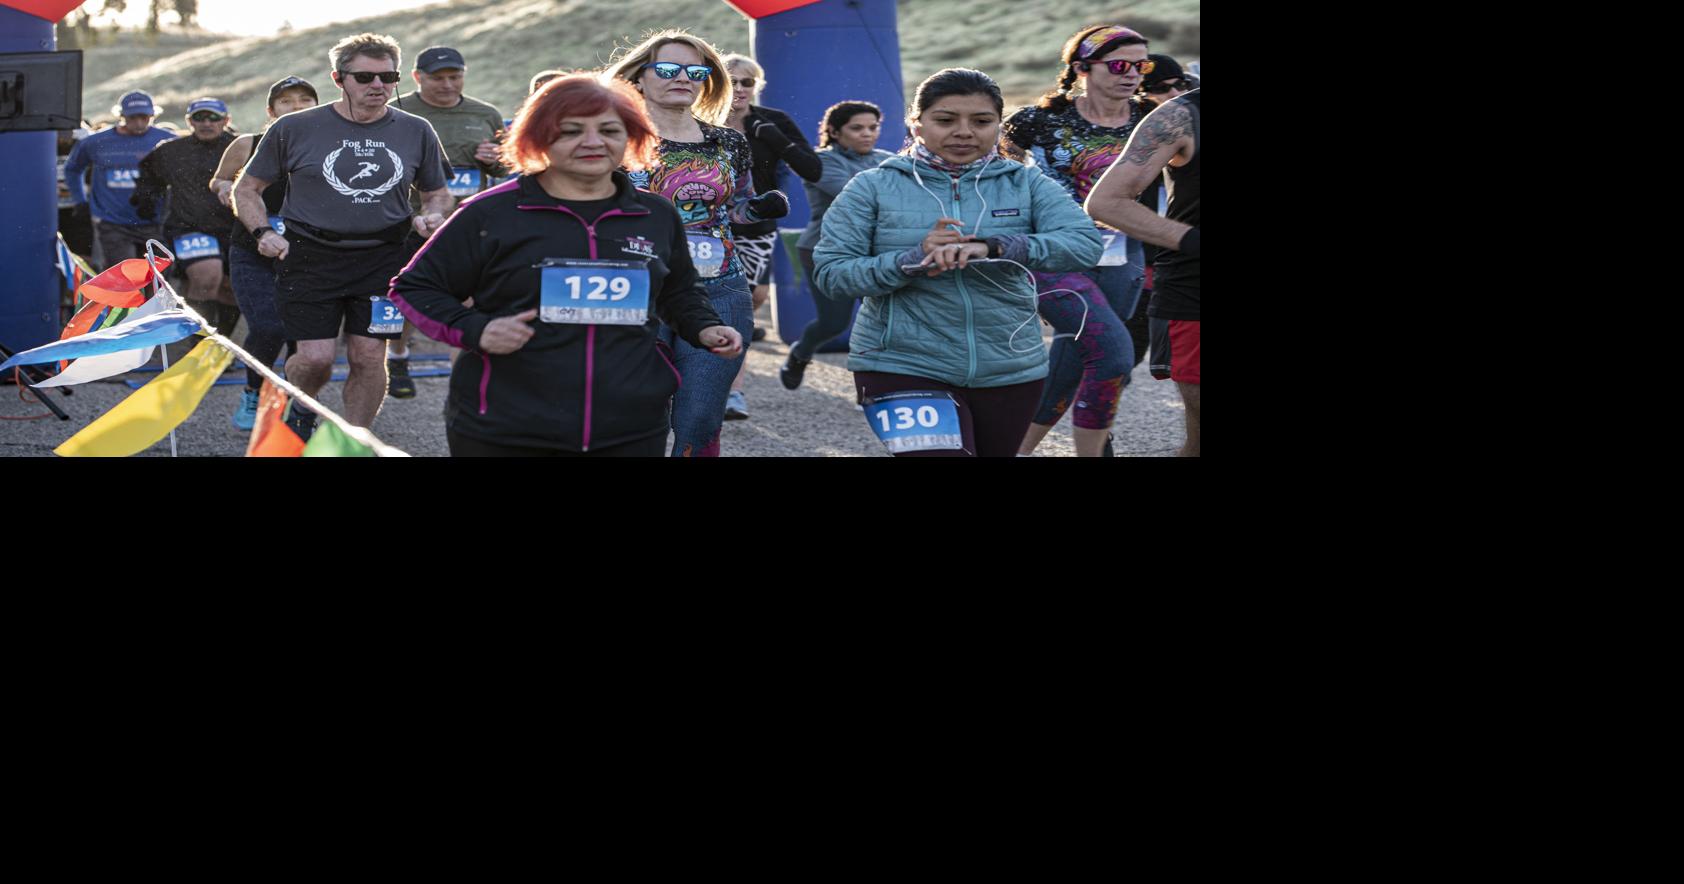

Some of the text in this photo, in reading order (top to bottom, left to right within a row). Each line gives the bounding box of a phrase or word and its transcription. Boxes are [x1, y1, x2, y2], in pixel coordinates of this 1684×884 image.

[343, 139, 386, 149] Fog Run
[182, 236, 210, 250] 345
[564, 276, 631, 301] 129
[876, 405, 939, 432] 130
